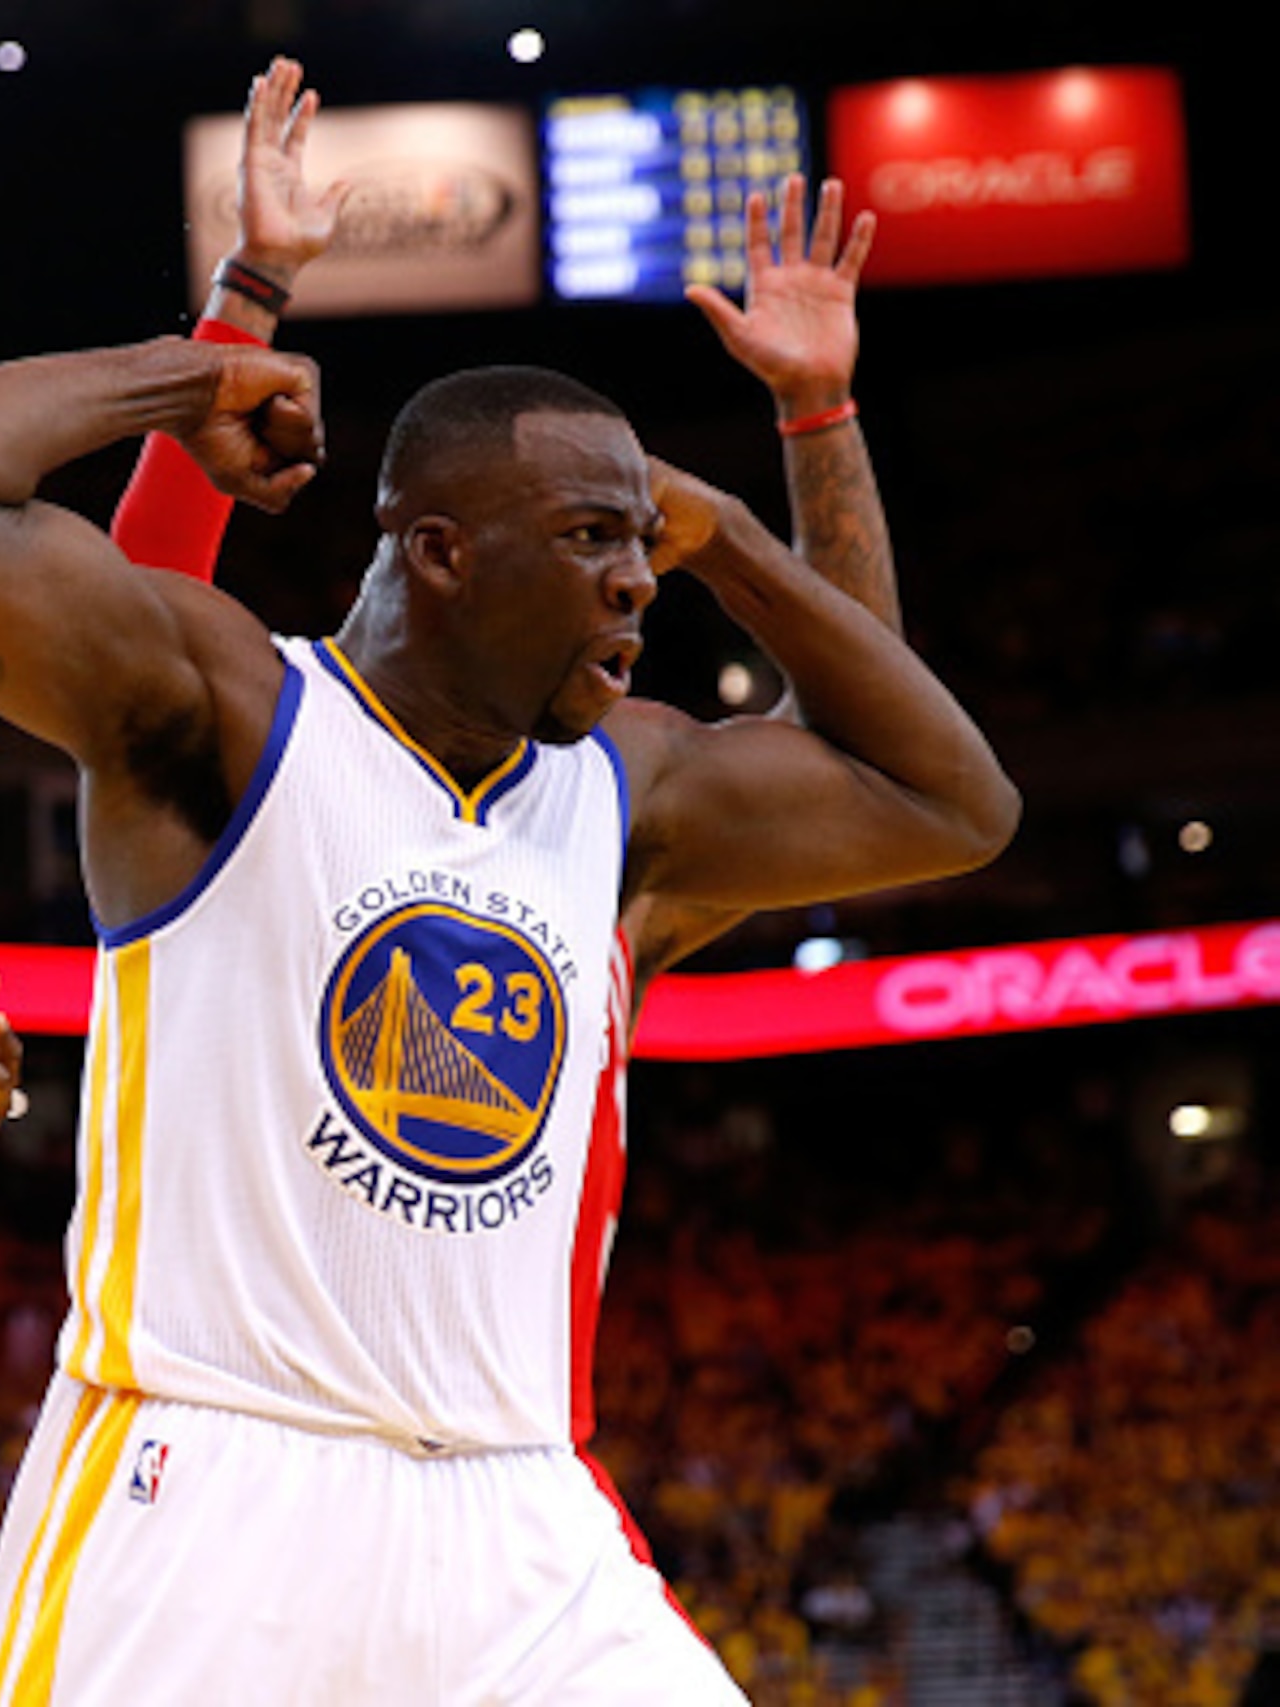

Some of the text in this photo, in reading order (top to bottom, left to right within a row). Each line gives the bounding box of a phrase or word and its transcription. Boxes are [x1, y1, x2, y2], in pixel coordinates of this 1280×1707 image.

[332, 870, 580, 986] GOLDEN STATE
[450, 963, 544, 1042] 23
[307, 1112, 553, 1233] WARRIORS
